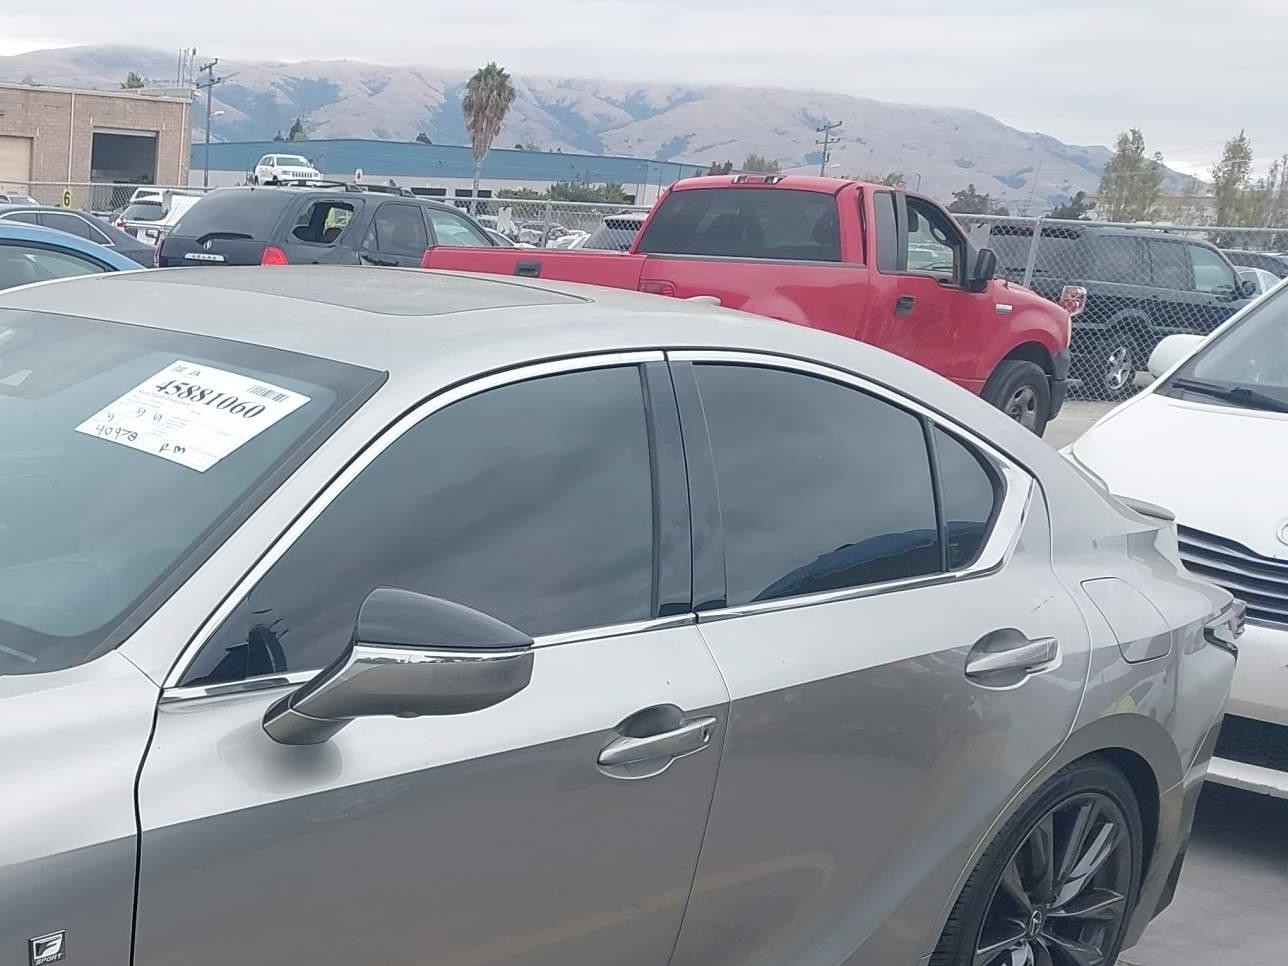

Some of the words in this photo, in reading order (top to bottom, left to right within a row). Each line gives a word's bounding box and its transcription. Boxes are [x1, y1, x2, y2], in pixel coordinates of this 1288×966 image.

[63, 191, 71, 207] 6
[155, 379, 267, 420] 45881060
[35, 952, 63, 966] SPORT
